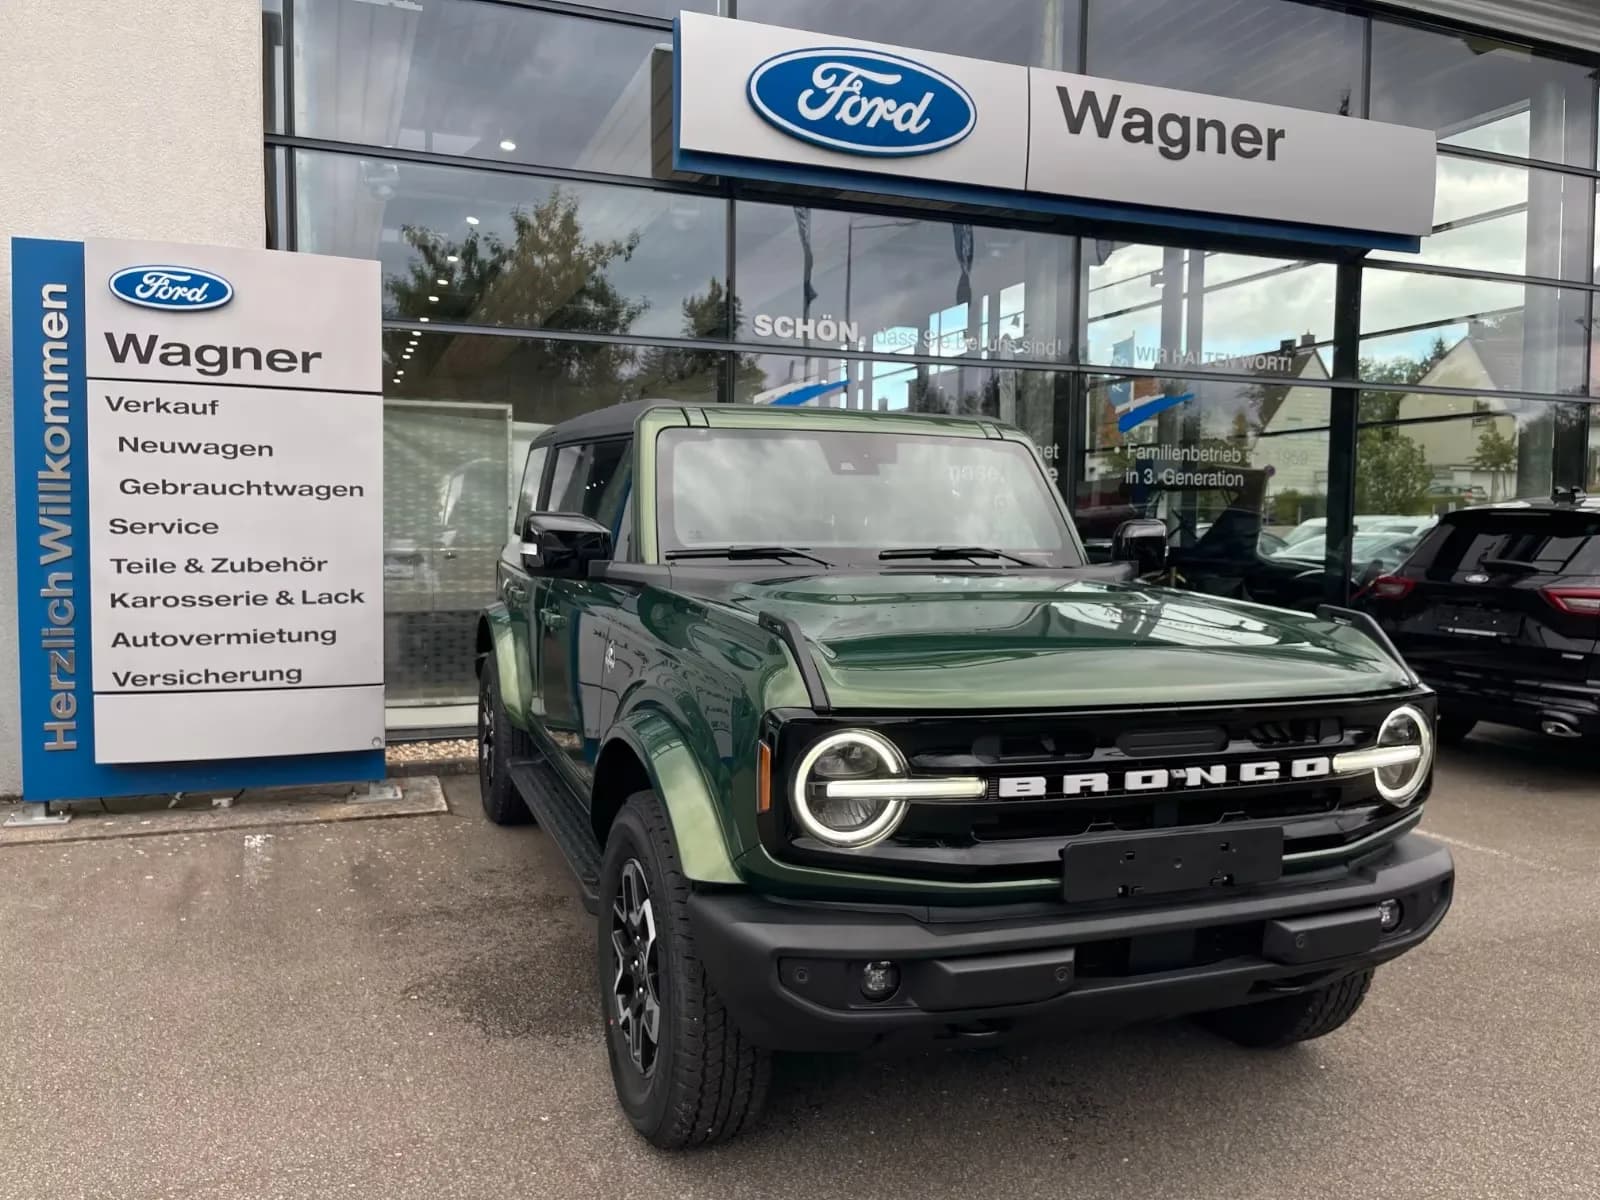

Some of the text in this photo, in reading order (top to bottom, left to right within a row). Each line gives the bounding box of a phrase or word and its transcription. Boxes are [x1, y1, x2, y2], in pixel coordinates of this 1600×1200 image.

[797, 61, 934, 136] Ford
[1056, 85, 1286, 161] Wagner
[135, 271, 210, 302] Ford
[753, 313, 867, 345] SCHÖN,
[876, 328, 918, 346] dass
[1022, 337, 1062, 356] sind!
[104, 331, 323, 377] Wagner
[1136, 346, 1168, 364] WIR
[1240, 353, 1293, 373] WORT!
[105, 395, 220, 416] Verkauf
[118, 436, 274, 459] Neuwagen
[1126, 443, 1242, 464] Familienbetrieb
[119, 477, 365, 500] Gebrauchtwagen
[1125, 468, 1244, 487] in 3. Generation
[37, 282, 78, 752] Herzlich Willkommen
[109, 517, 219, 535] Service
[110, 556, 328, 575] Teile & Zubehör
[110, 588, 366, 609] Karosserie & Lack
[111, 627, 338, 648] Autovermietung
[112, 667, 303, 688] Versicherung
[999, 756, 1330, 798] BRONCO
